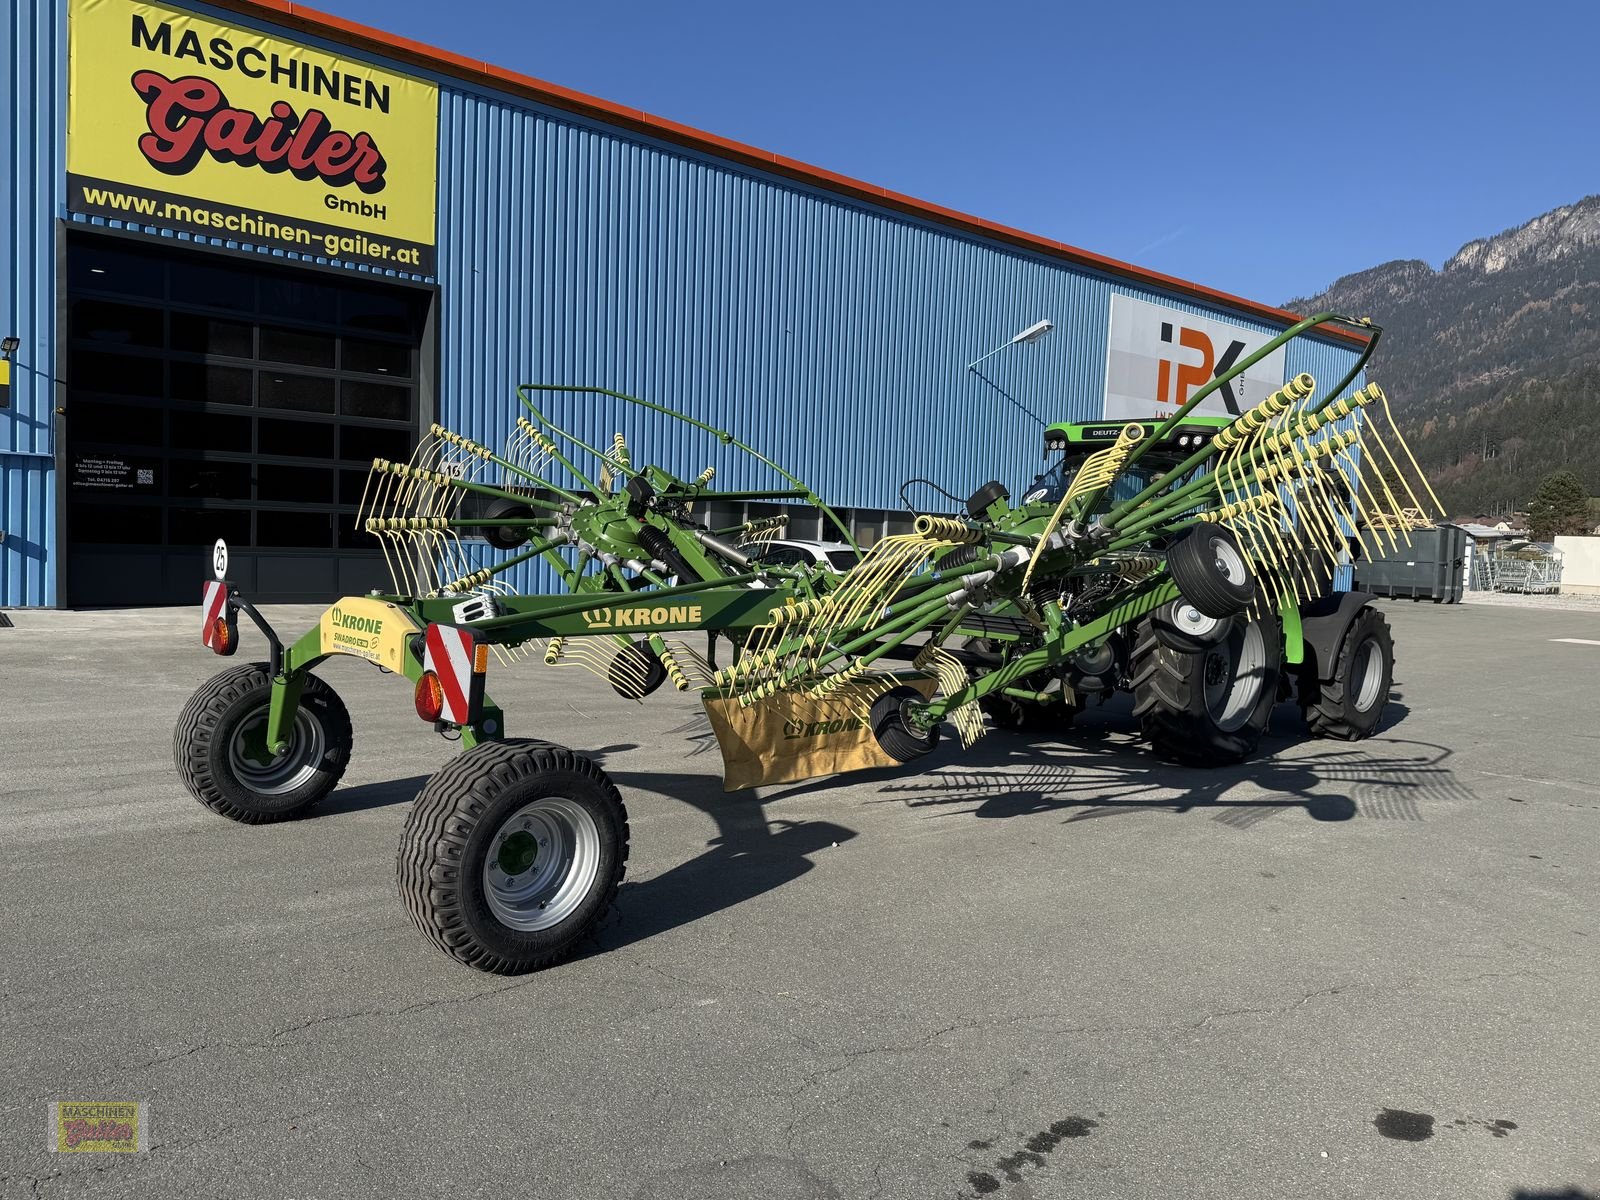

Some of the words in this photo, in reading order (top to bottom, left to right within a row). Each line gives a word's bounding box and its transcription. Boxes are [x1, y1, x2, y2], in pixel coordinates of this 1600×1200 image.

[131, 14, 390, 114] MASCHINEN
[131, 69, 387, 195] Gailer
[323, 193, 387, 221] GmbH
[82, 185, 420, 266] www.maschinen-gailer.at
[1092, 429, 1121, 437] DEUTZ-
[216, 546, 225, 571] 25
[341, 614, 383, 635] KRONE
[615, 605, 702, 627] KRONE
[333, 632, 357, 646] SWADRO
[803, 716, 869, 738] KRONE
